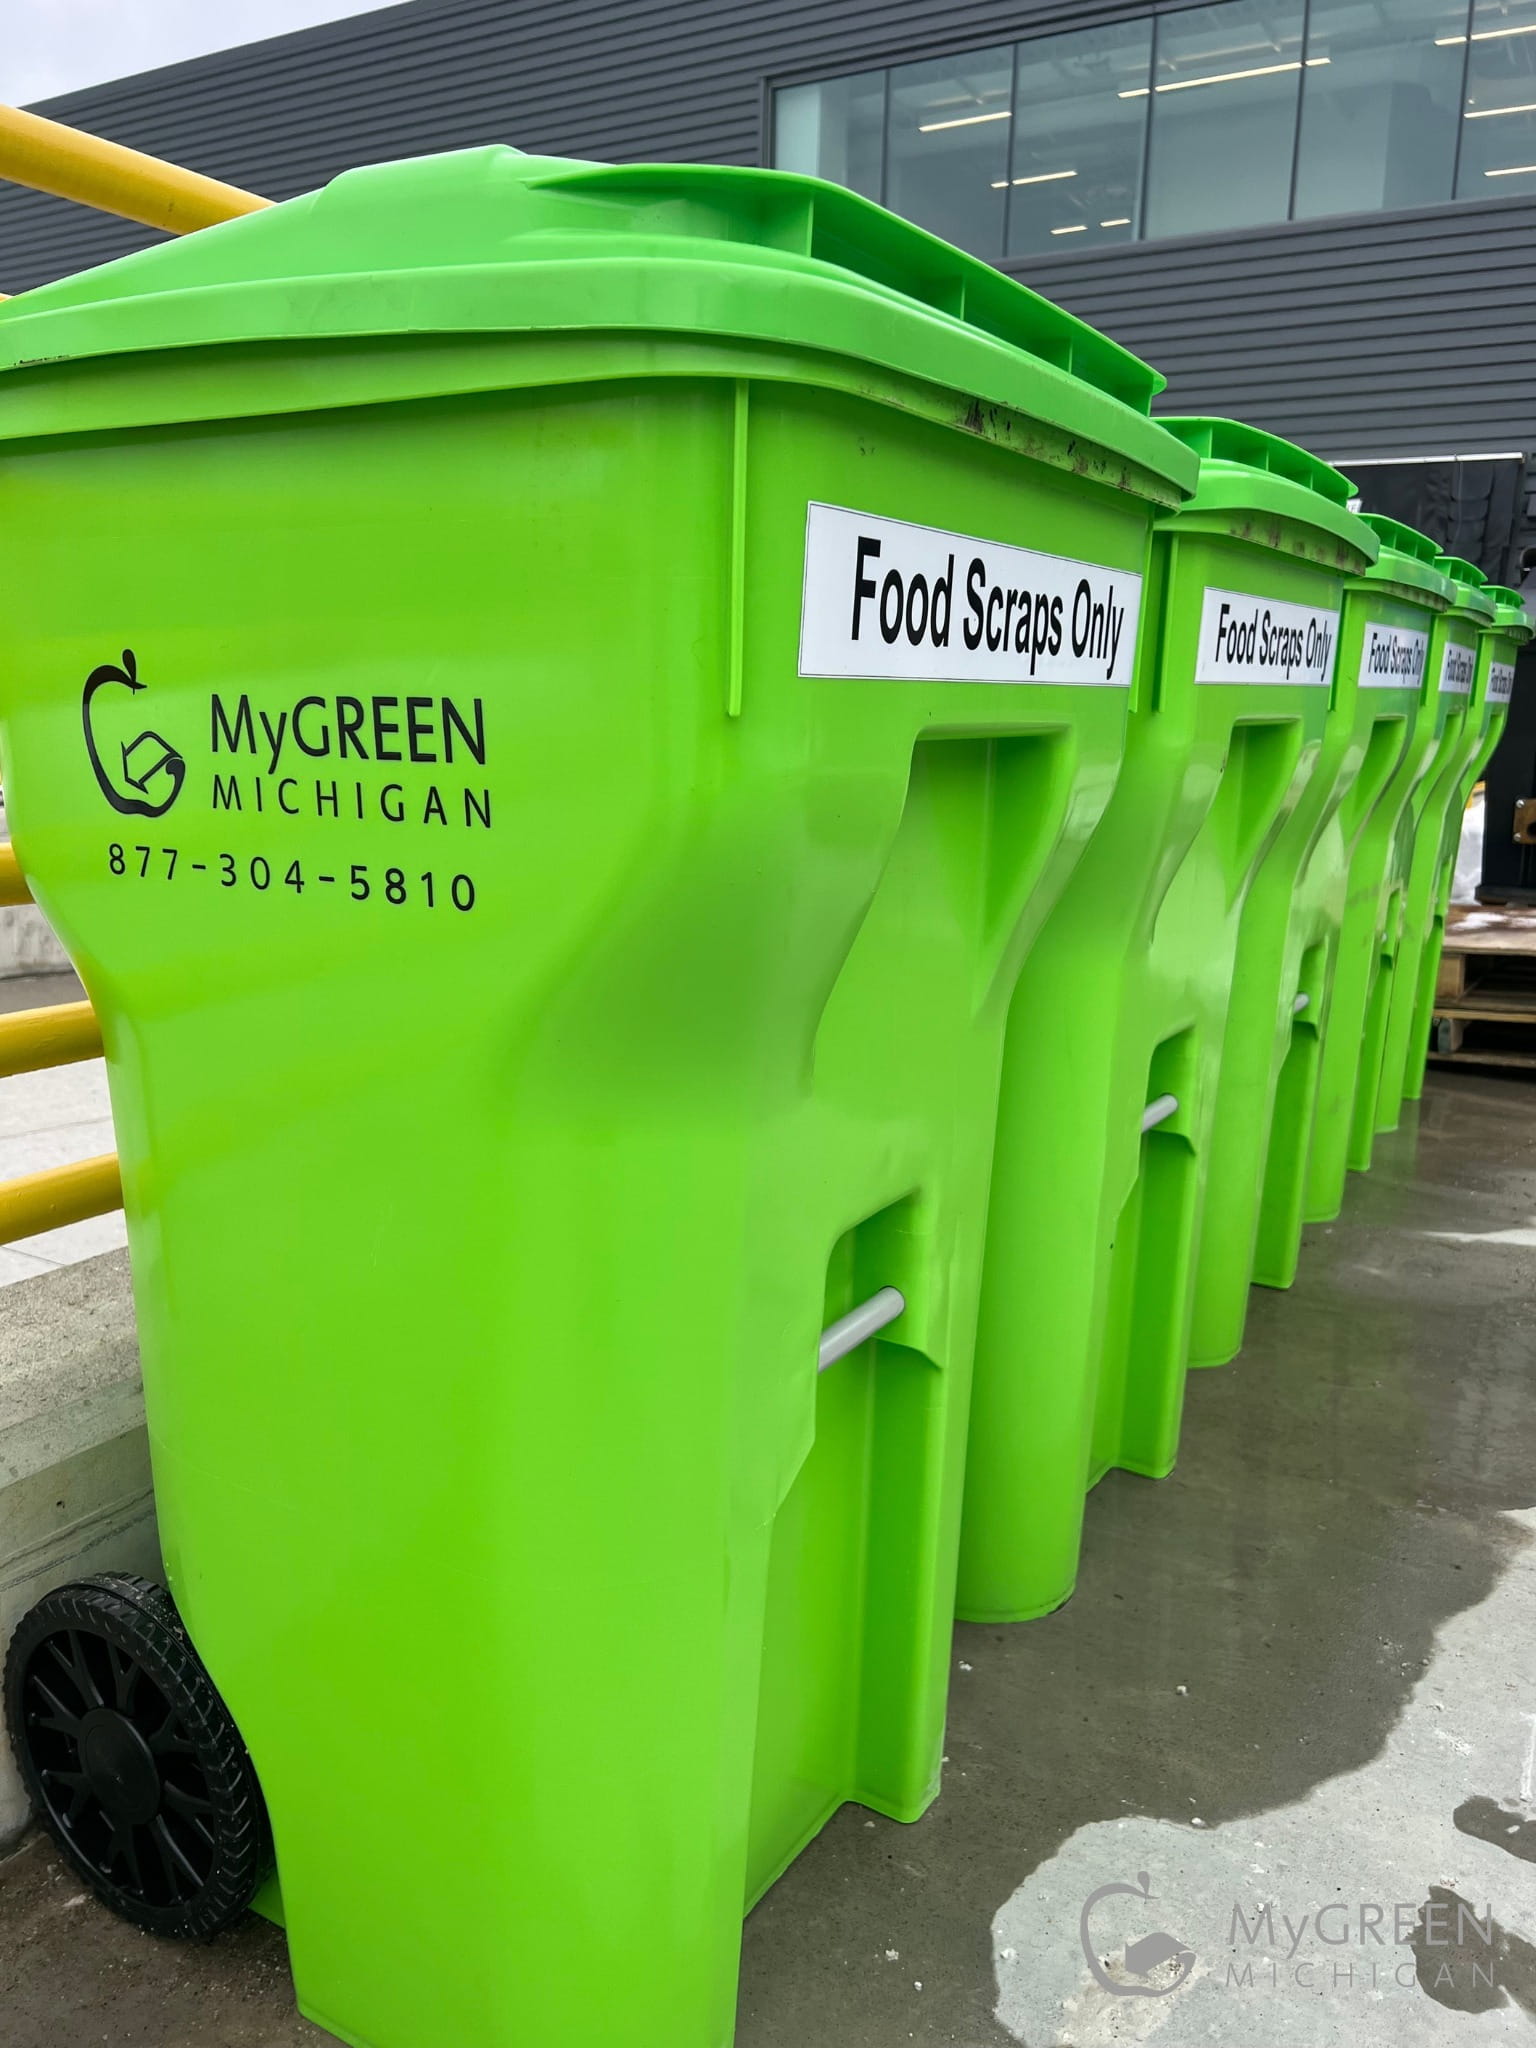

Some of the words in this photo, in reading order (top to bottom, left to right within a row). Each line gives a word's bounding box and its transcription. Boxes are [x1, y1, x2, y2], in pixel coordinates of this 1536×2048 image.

[851, 535, 955, 648] Food
[963, 557, 1064, 676] Scraps
[1071, 578, 1125, 681] Only
[1215, 603, 1259, 665] Food
[1259, 609, 1304, 680] Scraps
[1306, 617, 1332, 682] Only
[1368, 632, 1392, 674] Food
[210, 693, 486, 775] MyGREEN
[212, 774, 491, 828] MICHIGAN
[108, 843, 476, 912] 877-304-5810
